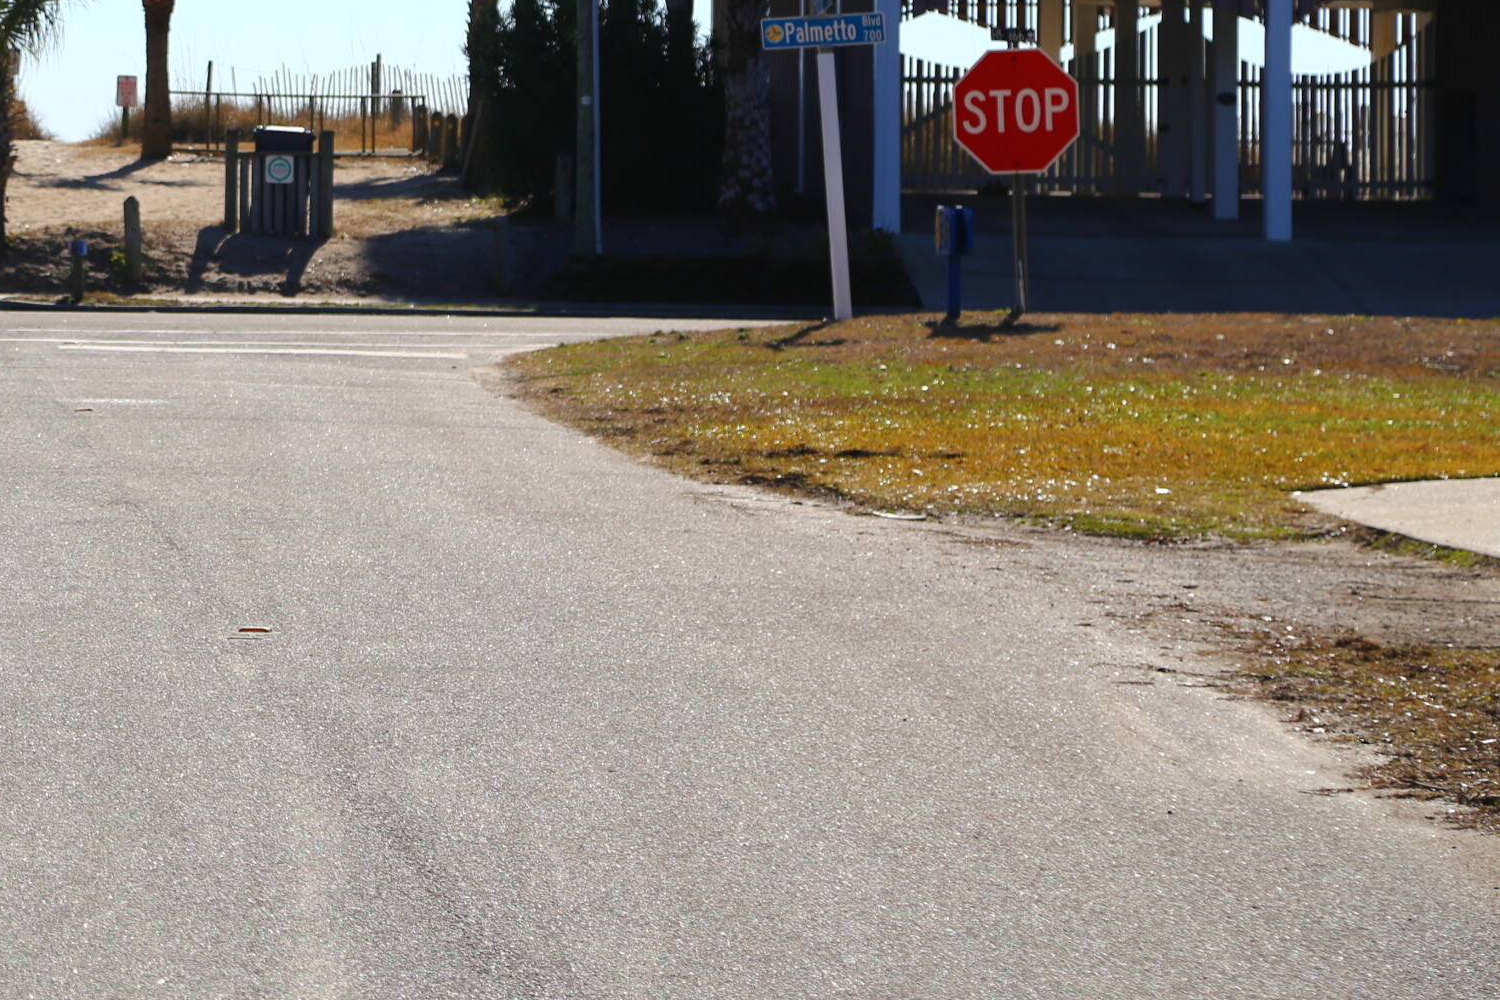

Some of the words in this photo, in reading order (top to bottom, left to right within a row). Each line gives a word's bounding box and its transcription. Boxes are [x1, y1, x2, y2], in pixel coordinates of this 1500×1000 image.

[784, 19, 857, 44] Palmetto
[862, 15, 881, 27] Blvd
[864, 29, 882, 42] 700
[963, 87, 1070, 135] STOP
